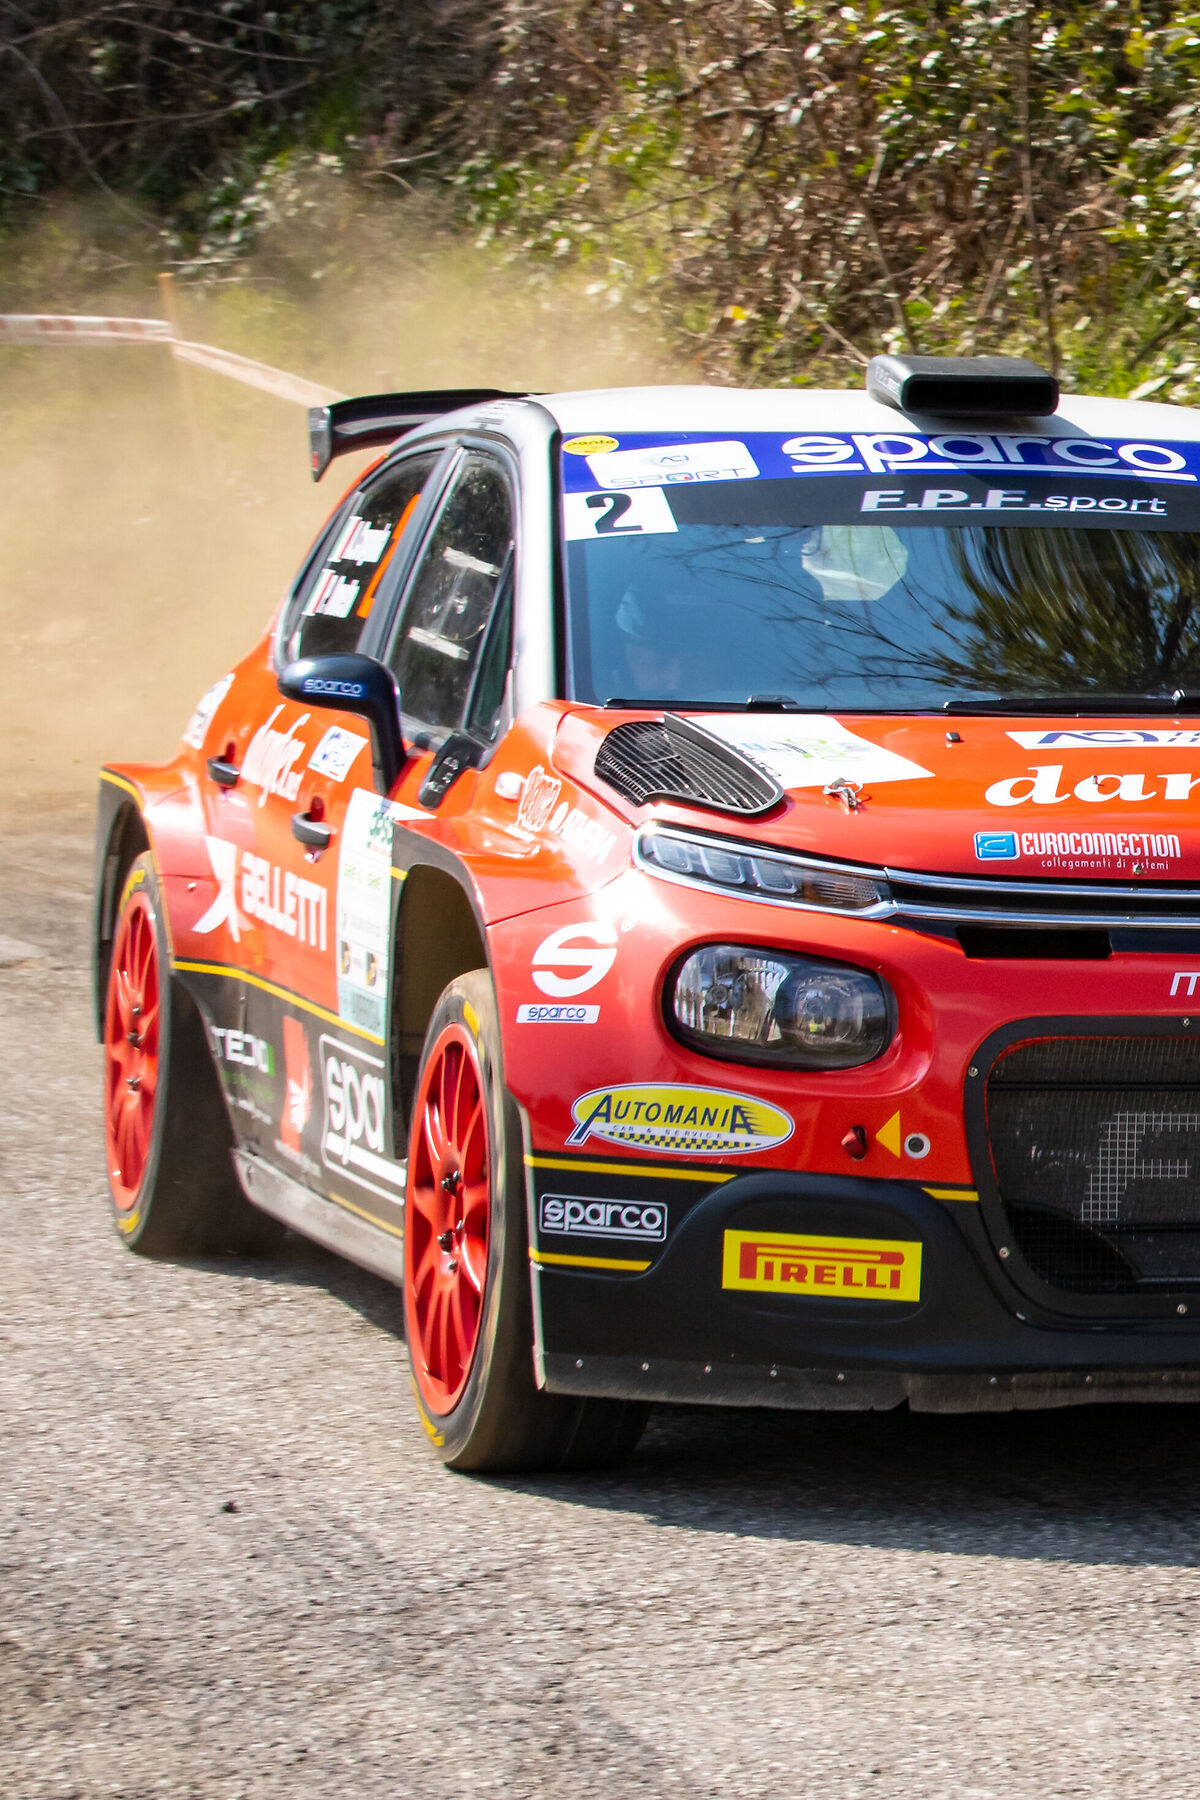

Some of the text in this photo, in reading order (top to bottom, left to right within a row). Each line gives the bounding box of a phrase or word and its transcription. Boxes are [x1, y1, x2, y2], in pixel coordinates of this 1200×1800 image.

[781, 434, 1192, 474] sparco
[610, 467, 747, 487] SPORT
[585, 492, 643, 534] 2
[304, 679, 362, 696] sparco
[1022, 832, 1181, 858] EUROCONNECTION
[1041, 857, 1111, 869] collegamenti
[1116, 858, 1126, 868] di
[528, 1006, 587, 1020] sparco
[568, 1094, 758, 1143] AUTOMANIA
[665, 1128, 723, 1140] SERVICE
[543, 1199, 662, 1234] sparco
[739, 1241, 905, 1289] PIRELLI
